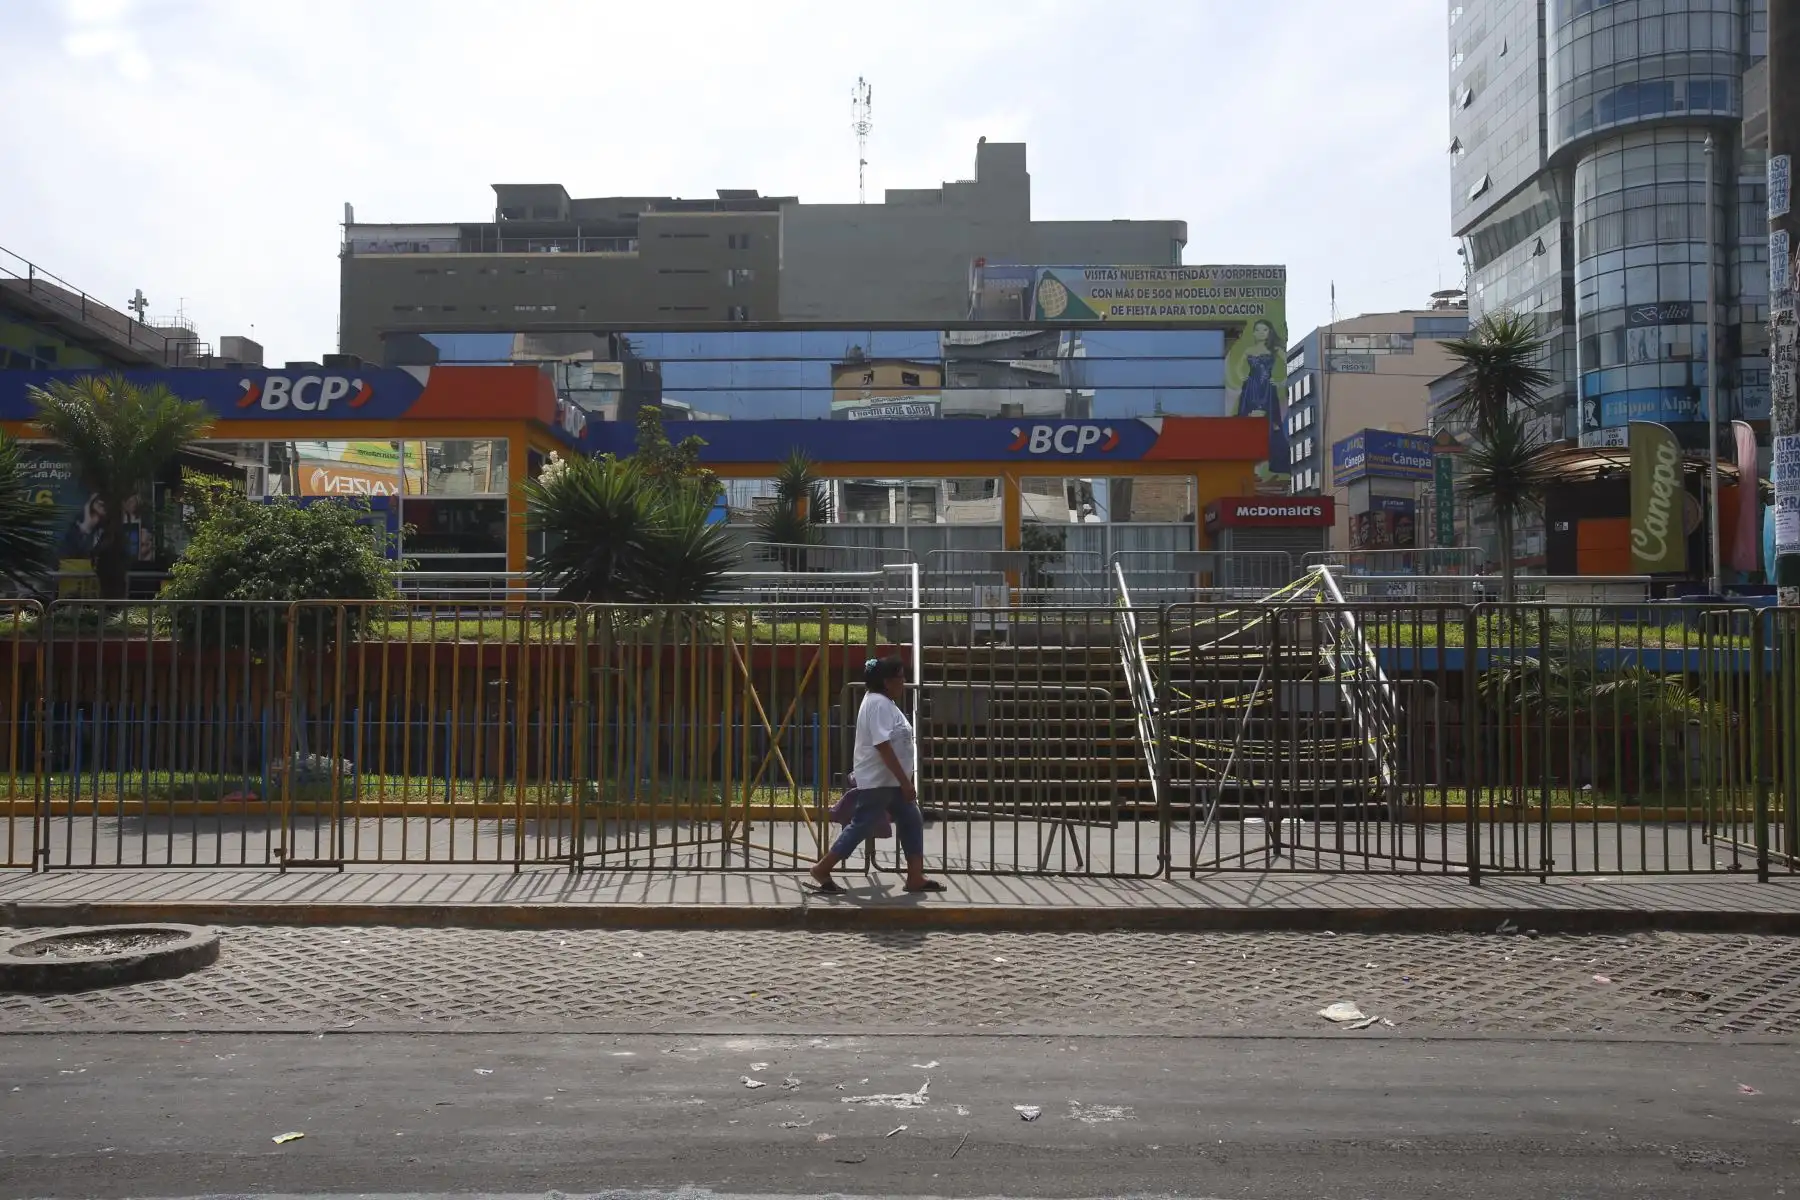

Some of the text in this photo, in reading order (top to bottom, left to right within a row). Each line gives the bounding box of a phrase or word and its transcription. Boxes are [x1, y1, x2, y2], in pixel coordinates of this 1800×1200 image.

[1084, 269, 1118, 281] VISITAS
[1121, 269, 1168, 281] NUESTRAS
[1169, 269, 1210, 280] TIENDAS
[1212, 269, 1219, 280] Y
[1091, 288, 1114, 298] CON
[1115, 288, 1135, 299] MAS
[1137, 288, 1150, 299] DE
[1174, 287, 1221, 299] MODELOS
[1223, 287, 1237, 298] EN
[1239, 286, 1284, 298] VESTIDOS
[1111, 304, 1264, 316] DE FIESTA PARA TODA OCACION
[261, 376, 350, 410] BCP
[1029, 424, 1101, 454] BCP
[1236, 506, 1322, 517] McDonald's
